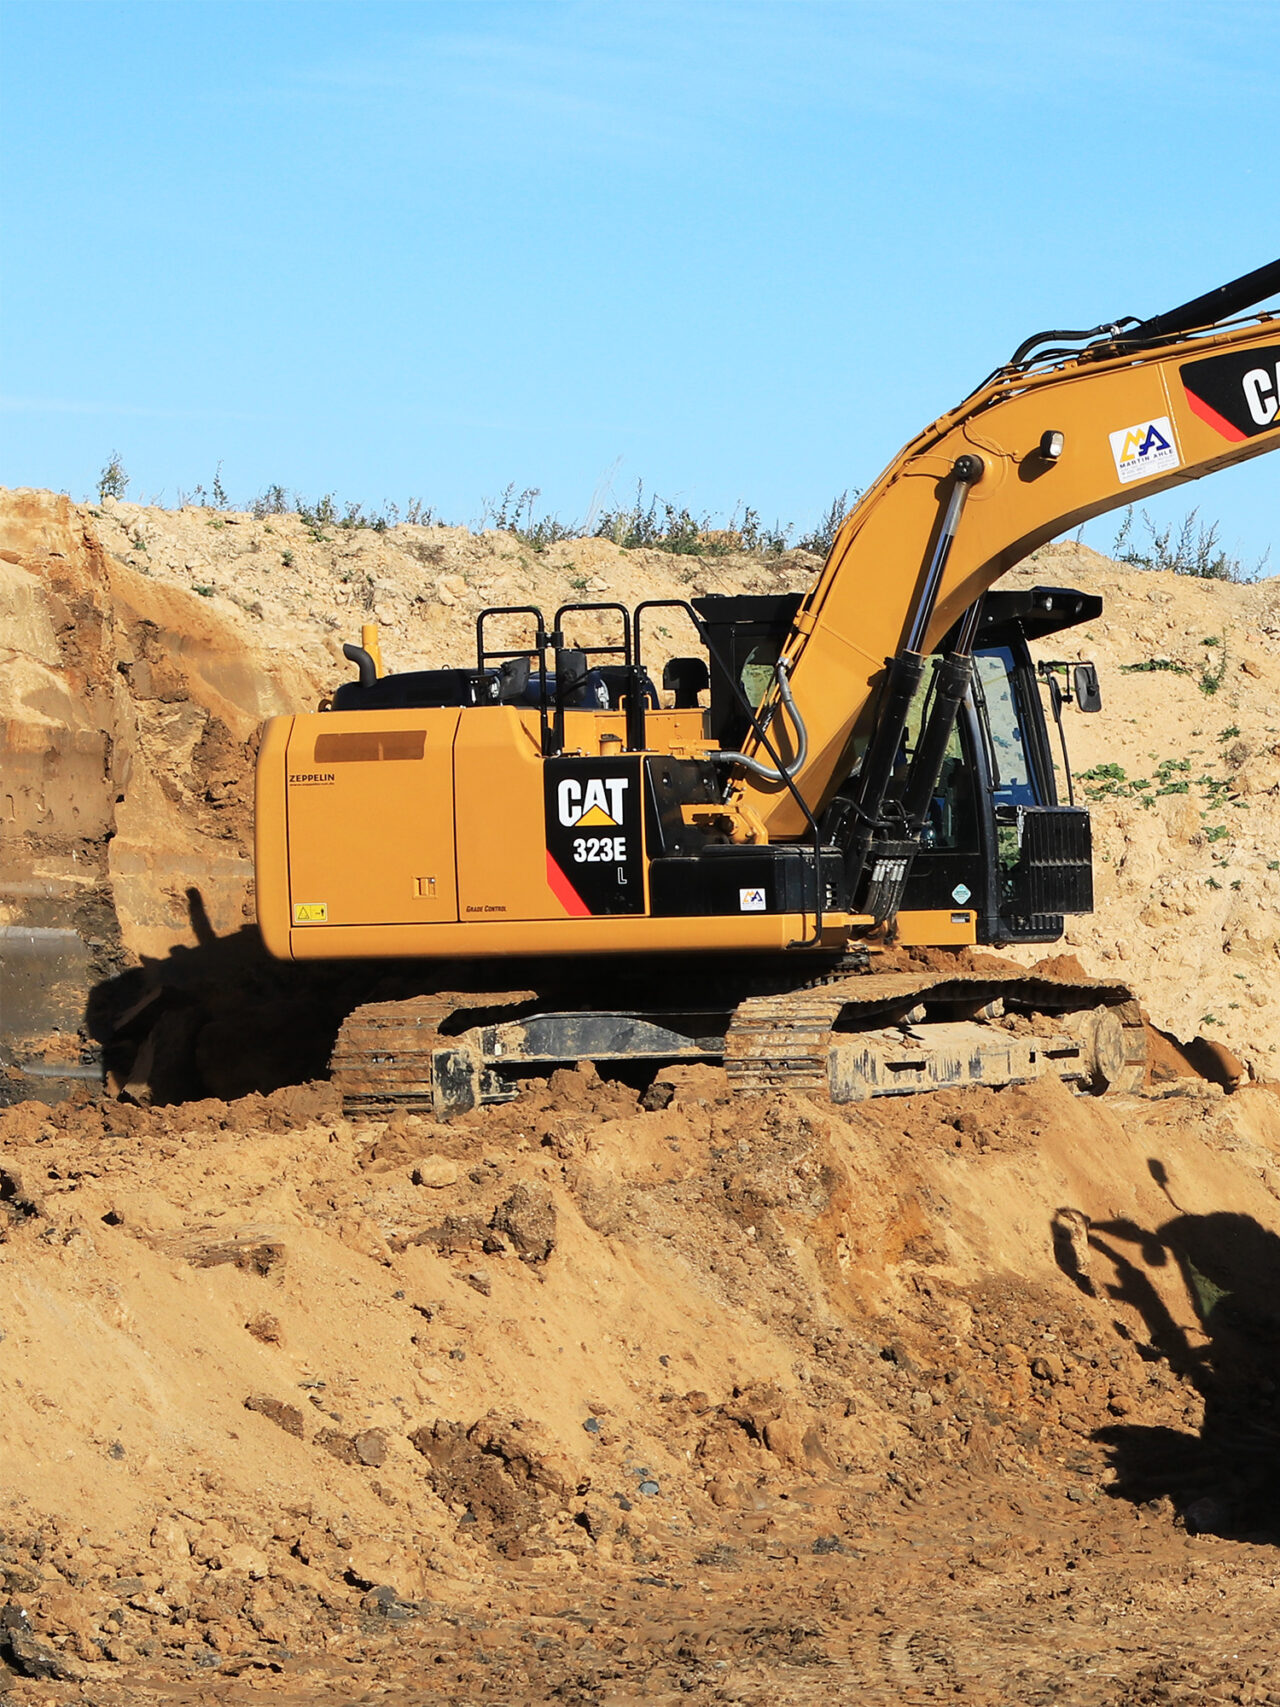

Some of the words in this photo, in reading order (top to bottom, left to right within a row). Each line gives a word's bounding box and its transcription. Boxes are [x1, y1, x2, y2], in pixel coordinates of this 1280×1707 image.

[1120, 456, 1150, 468] MARTIN
[289, 773, 335, 782] ZEPPELIN
[558, 778, 629, 827] CAT
[573, 837, 627, 863] 323E
[617, 866, 628, 884] L
